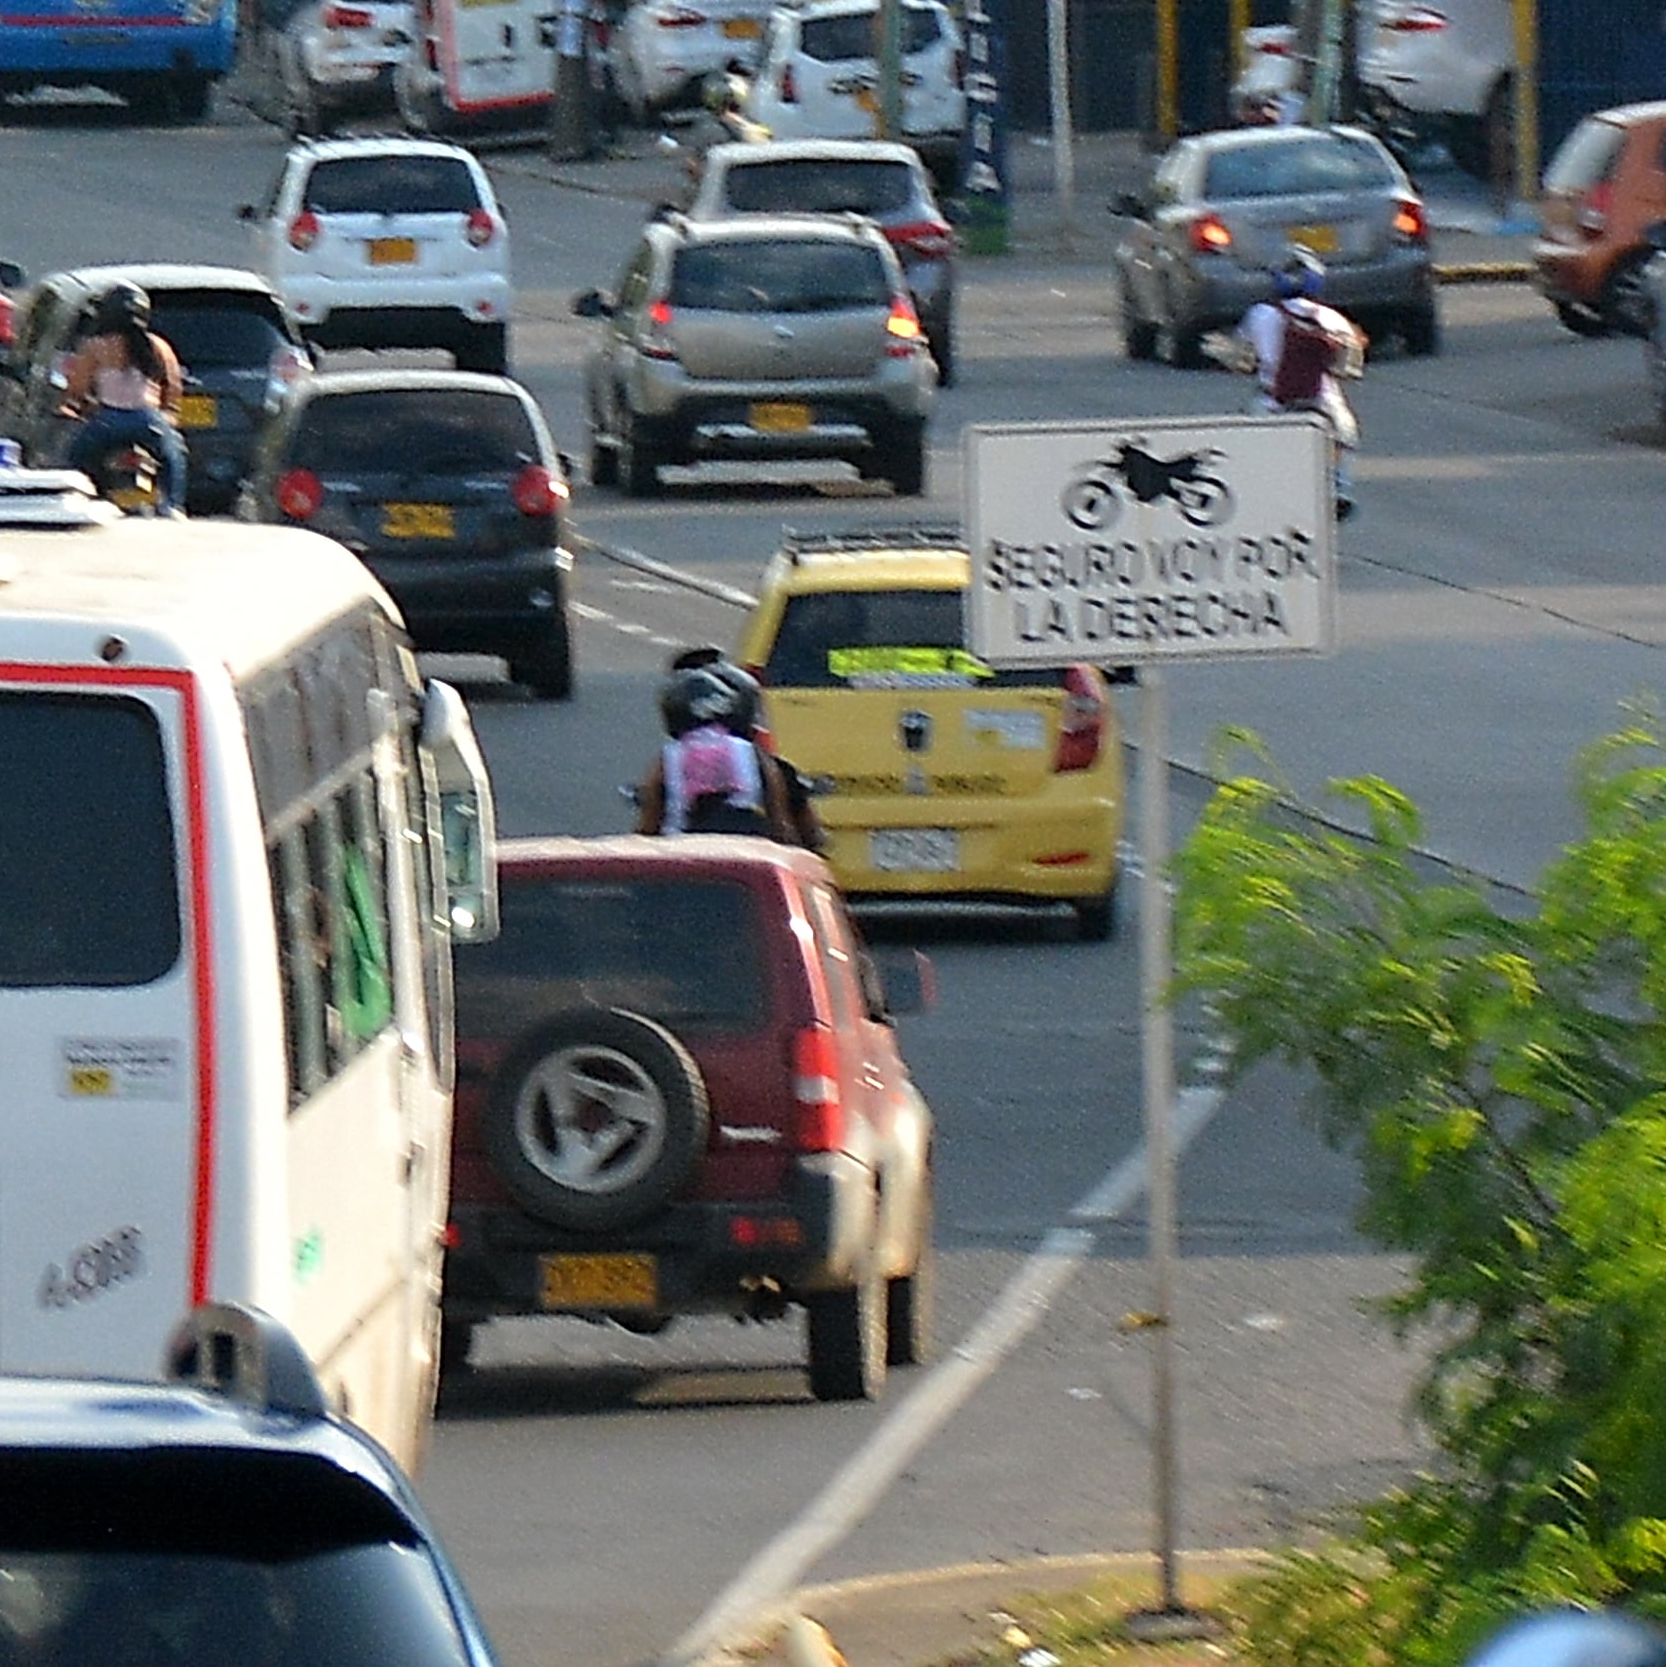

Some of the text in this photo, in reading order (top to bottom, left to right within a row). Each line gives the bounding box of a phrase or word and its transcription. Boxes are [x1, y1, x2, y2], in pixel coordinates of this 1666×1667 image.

[987, 527, 1321, 591] SEGURO VOY POR
[1014, 590, 1289, 642] LA DERECHA
